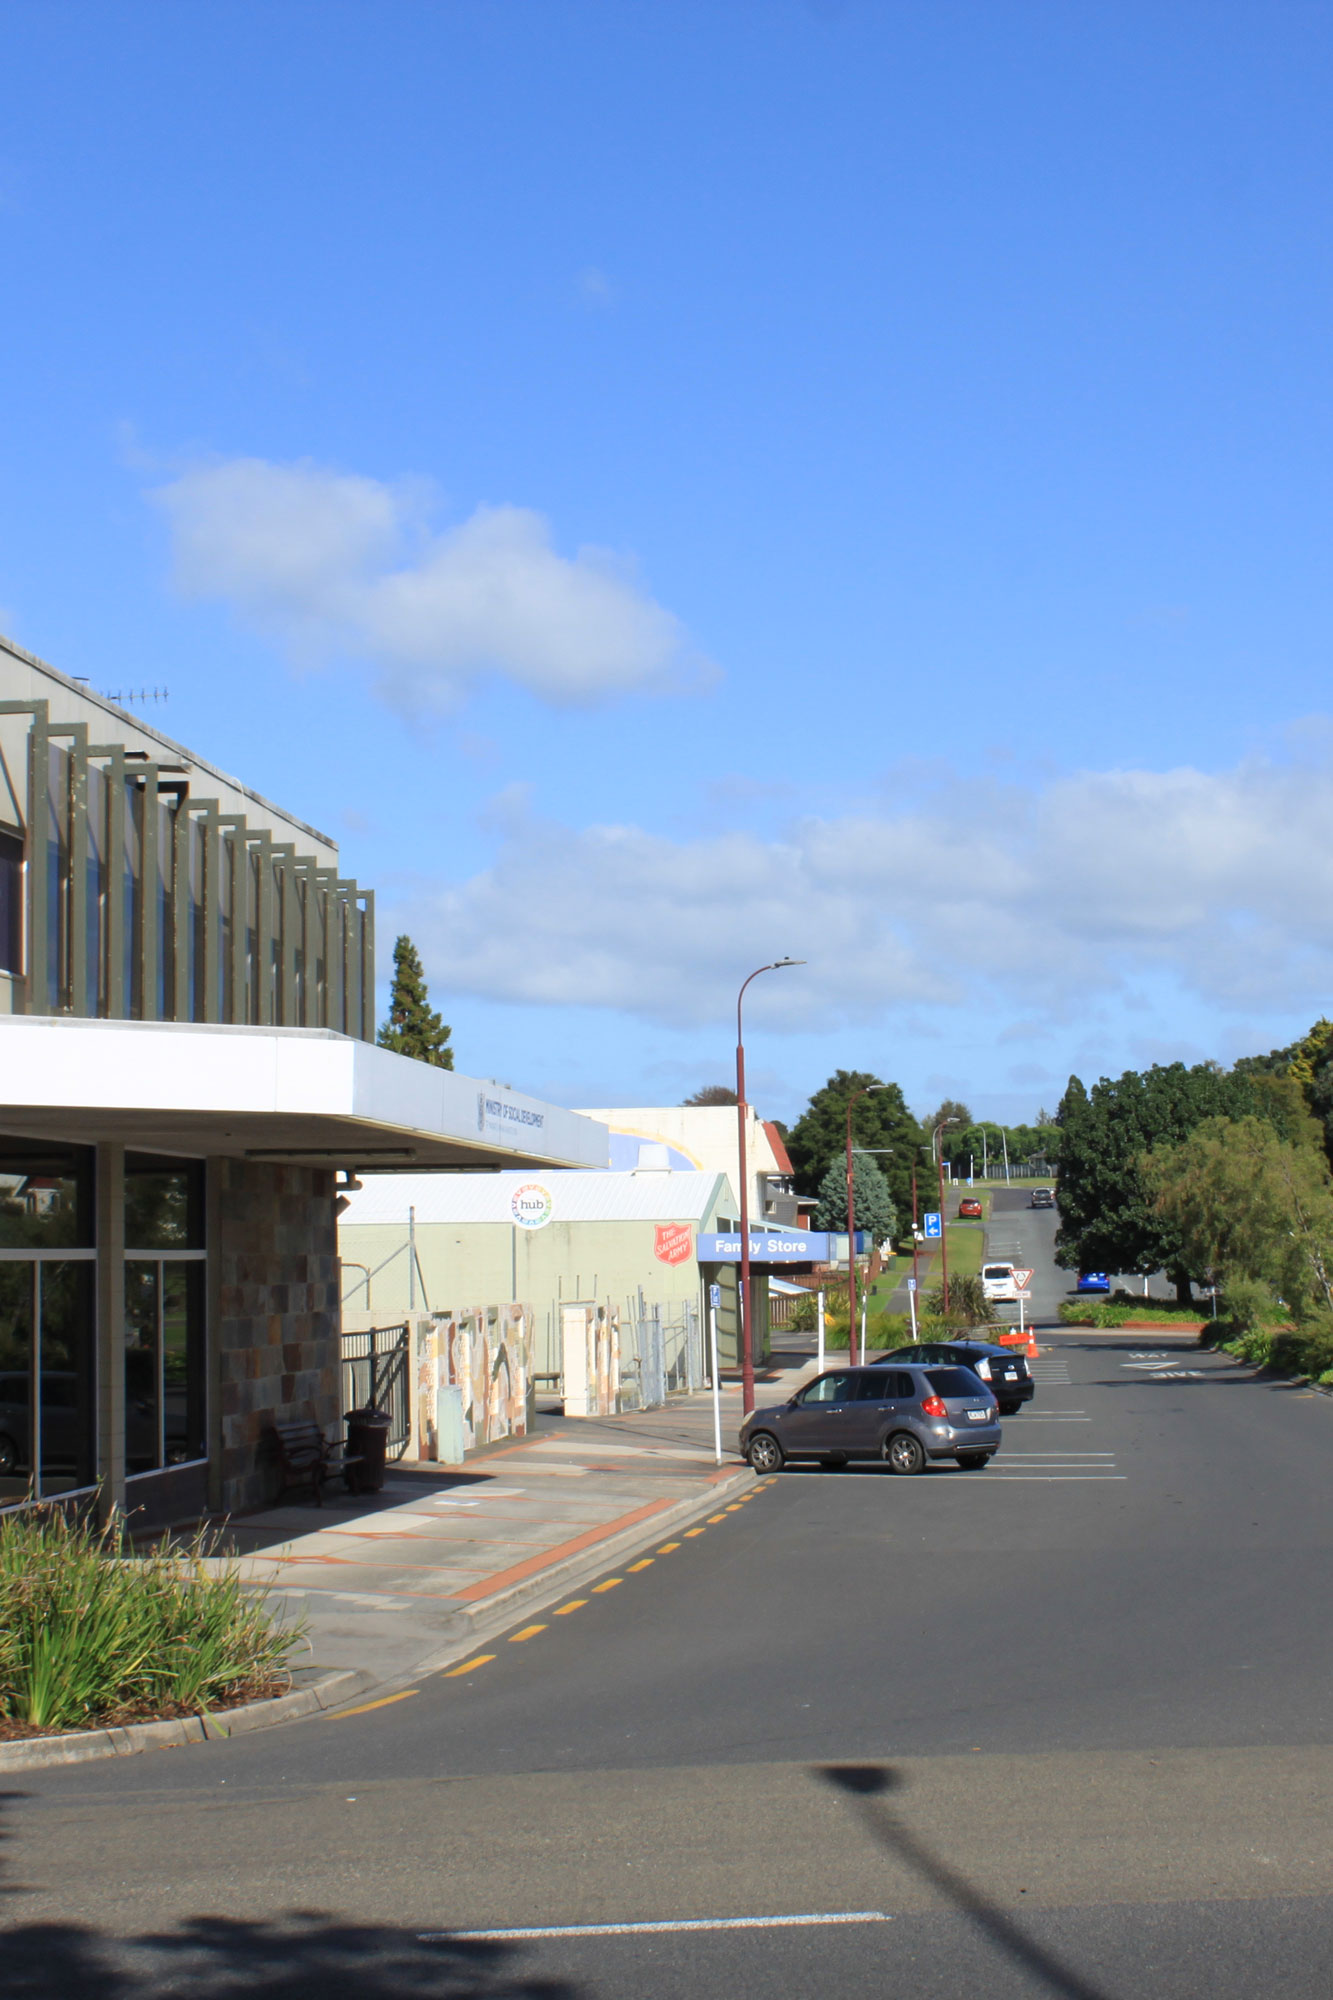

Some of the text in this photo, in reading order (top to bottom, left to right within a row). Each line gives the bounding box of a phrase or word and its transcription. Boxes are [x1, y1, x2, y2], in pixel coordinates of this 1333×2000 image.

[520, 1199, 544, 1209] hub
[928, 1215, 937, 1226] P
[662, 1227, 677, 1241] THE
[656, 1229, 690, 1256] SALVATION
[715, 1239, 807, 1255] Famly Store
[668, 1241, 688, 1261] ARMY
[1149, 1370, 1205, 1378] GIVE
